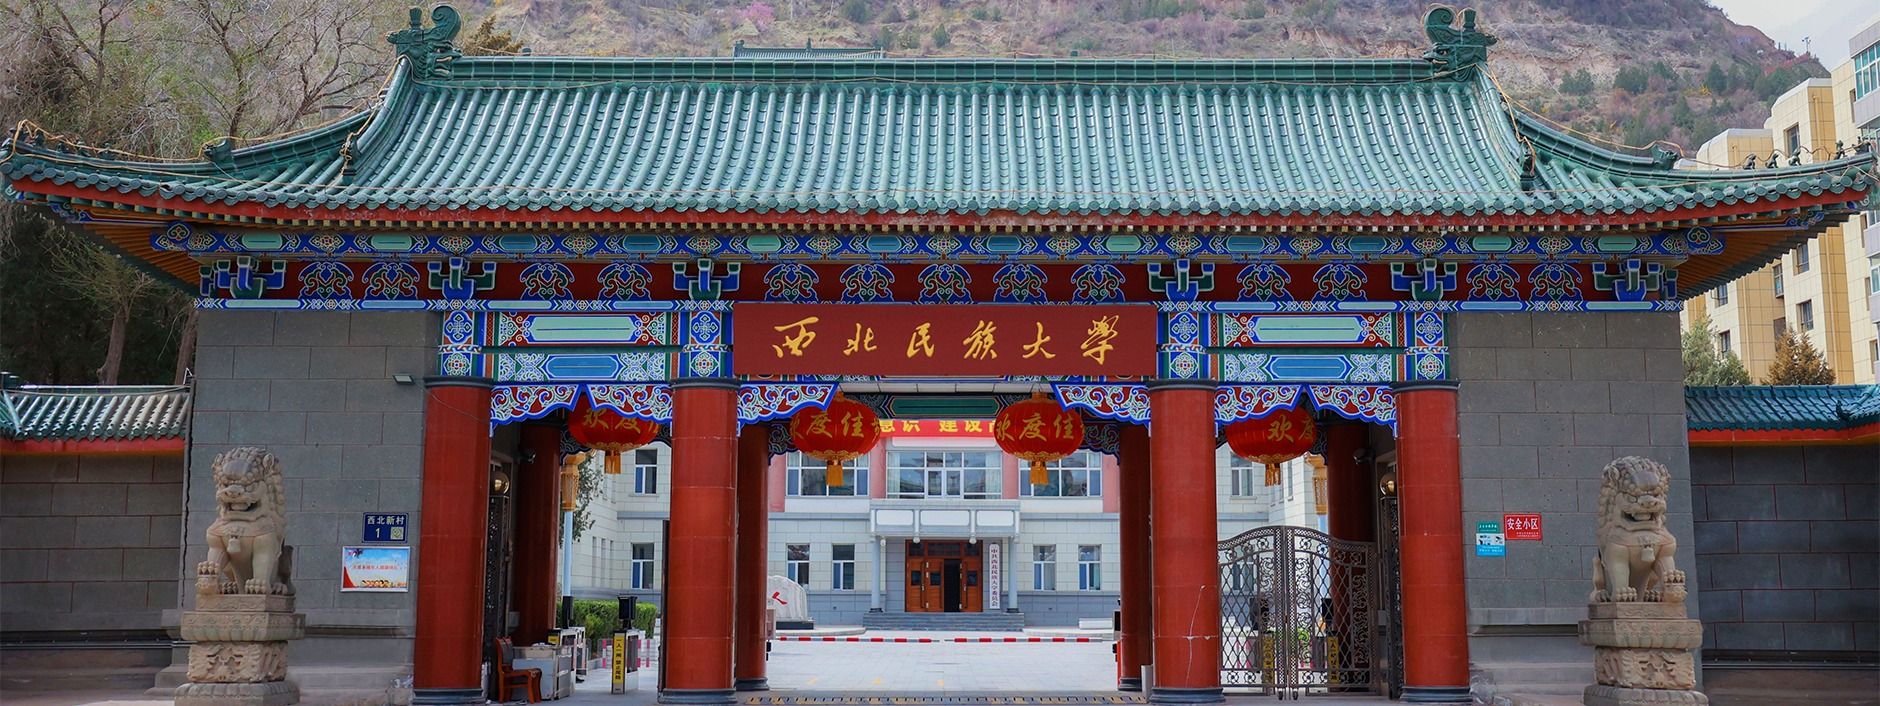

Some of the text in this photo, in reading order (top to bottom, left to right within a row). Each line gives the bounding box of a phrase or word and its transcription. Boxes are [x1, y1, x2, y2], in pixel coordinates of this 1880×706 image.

[773, 315, 1120, 365] 西北民族大學
[583, 407, 659, 434] 欢度
[367, 515, 405, 525] 西北新村
[1507, 517, 1539, 530] 安全小区
[375, 528, 380, 538] 1
